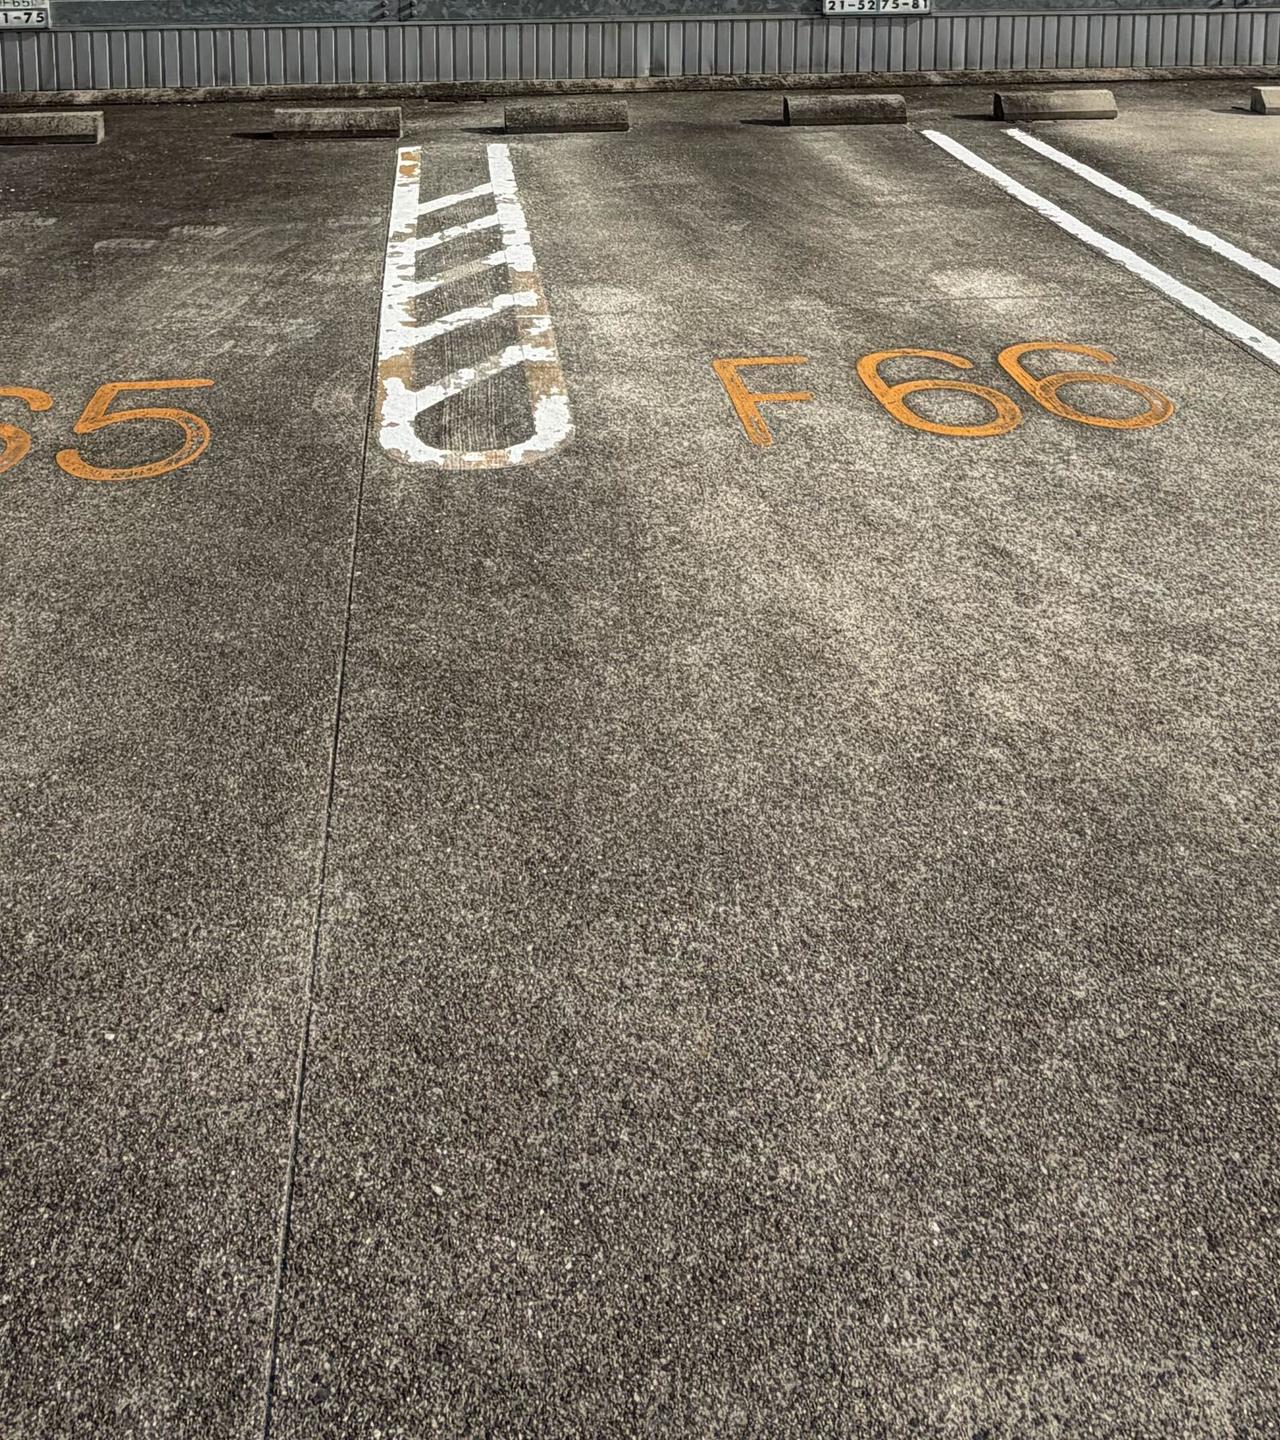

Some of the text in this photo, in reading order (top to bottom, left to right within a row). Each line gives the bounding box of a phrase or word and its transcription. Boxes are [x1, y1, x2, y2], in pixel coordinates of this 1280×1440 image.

[828, 0, 928, 11] 21-52 75-81
[712, 341, 1176, 446] F66
